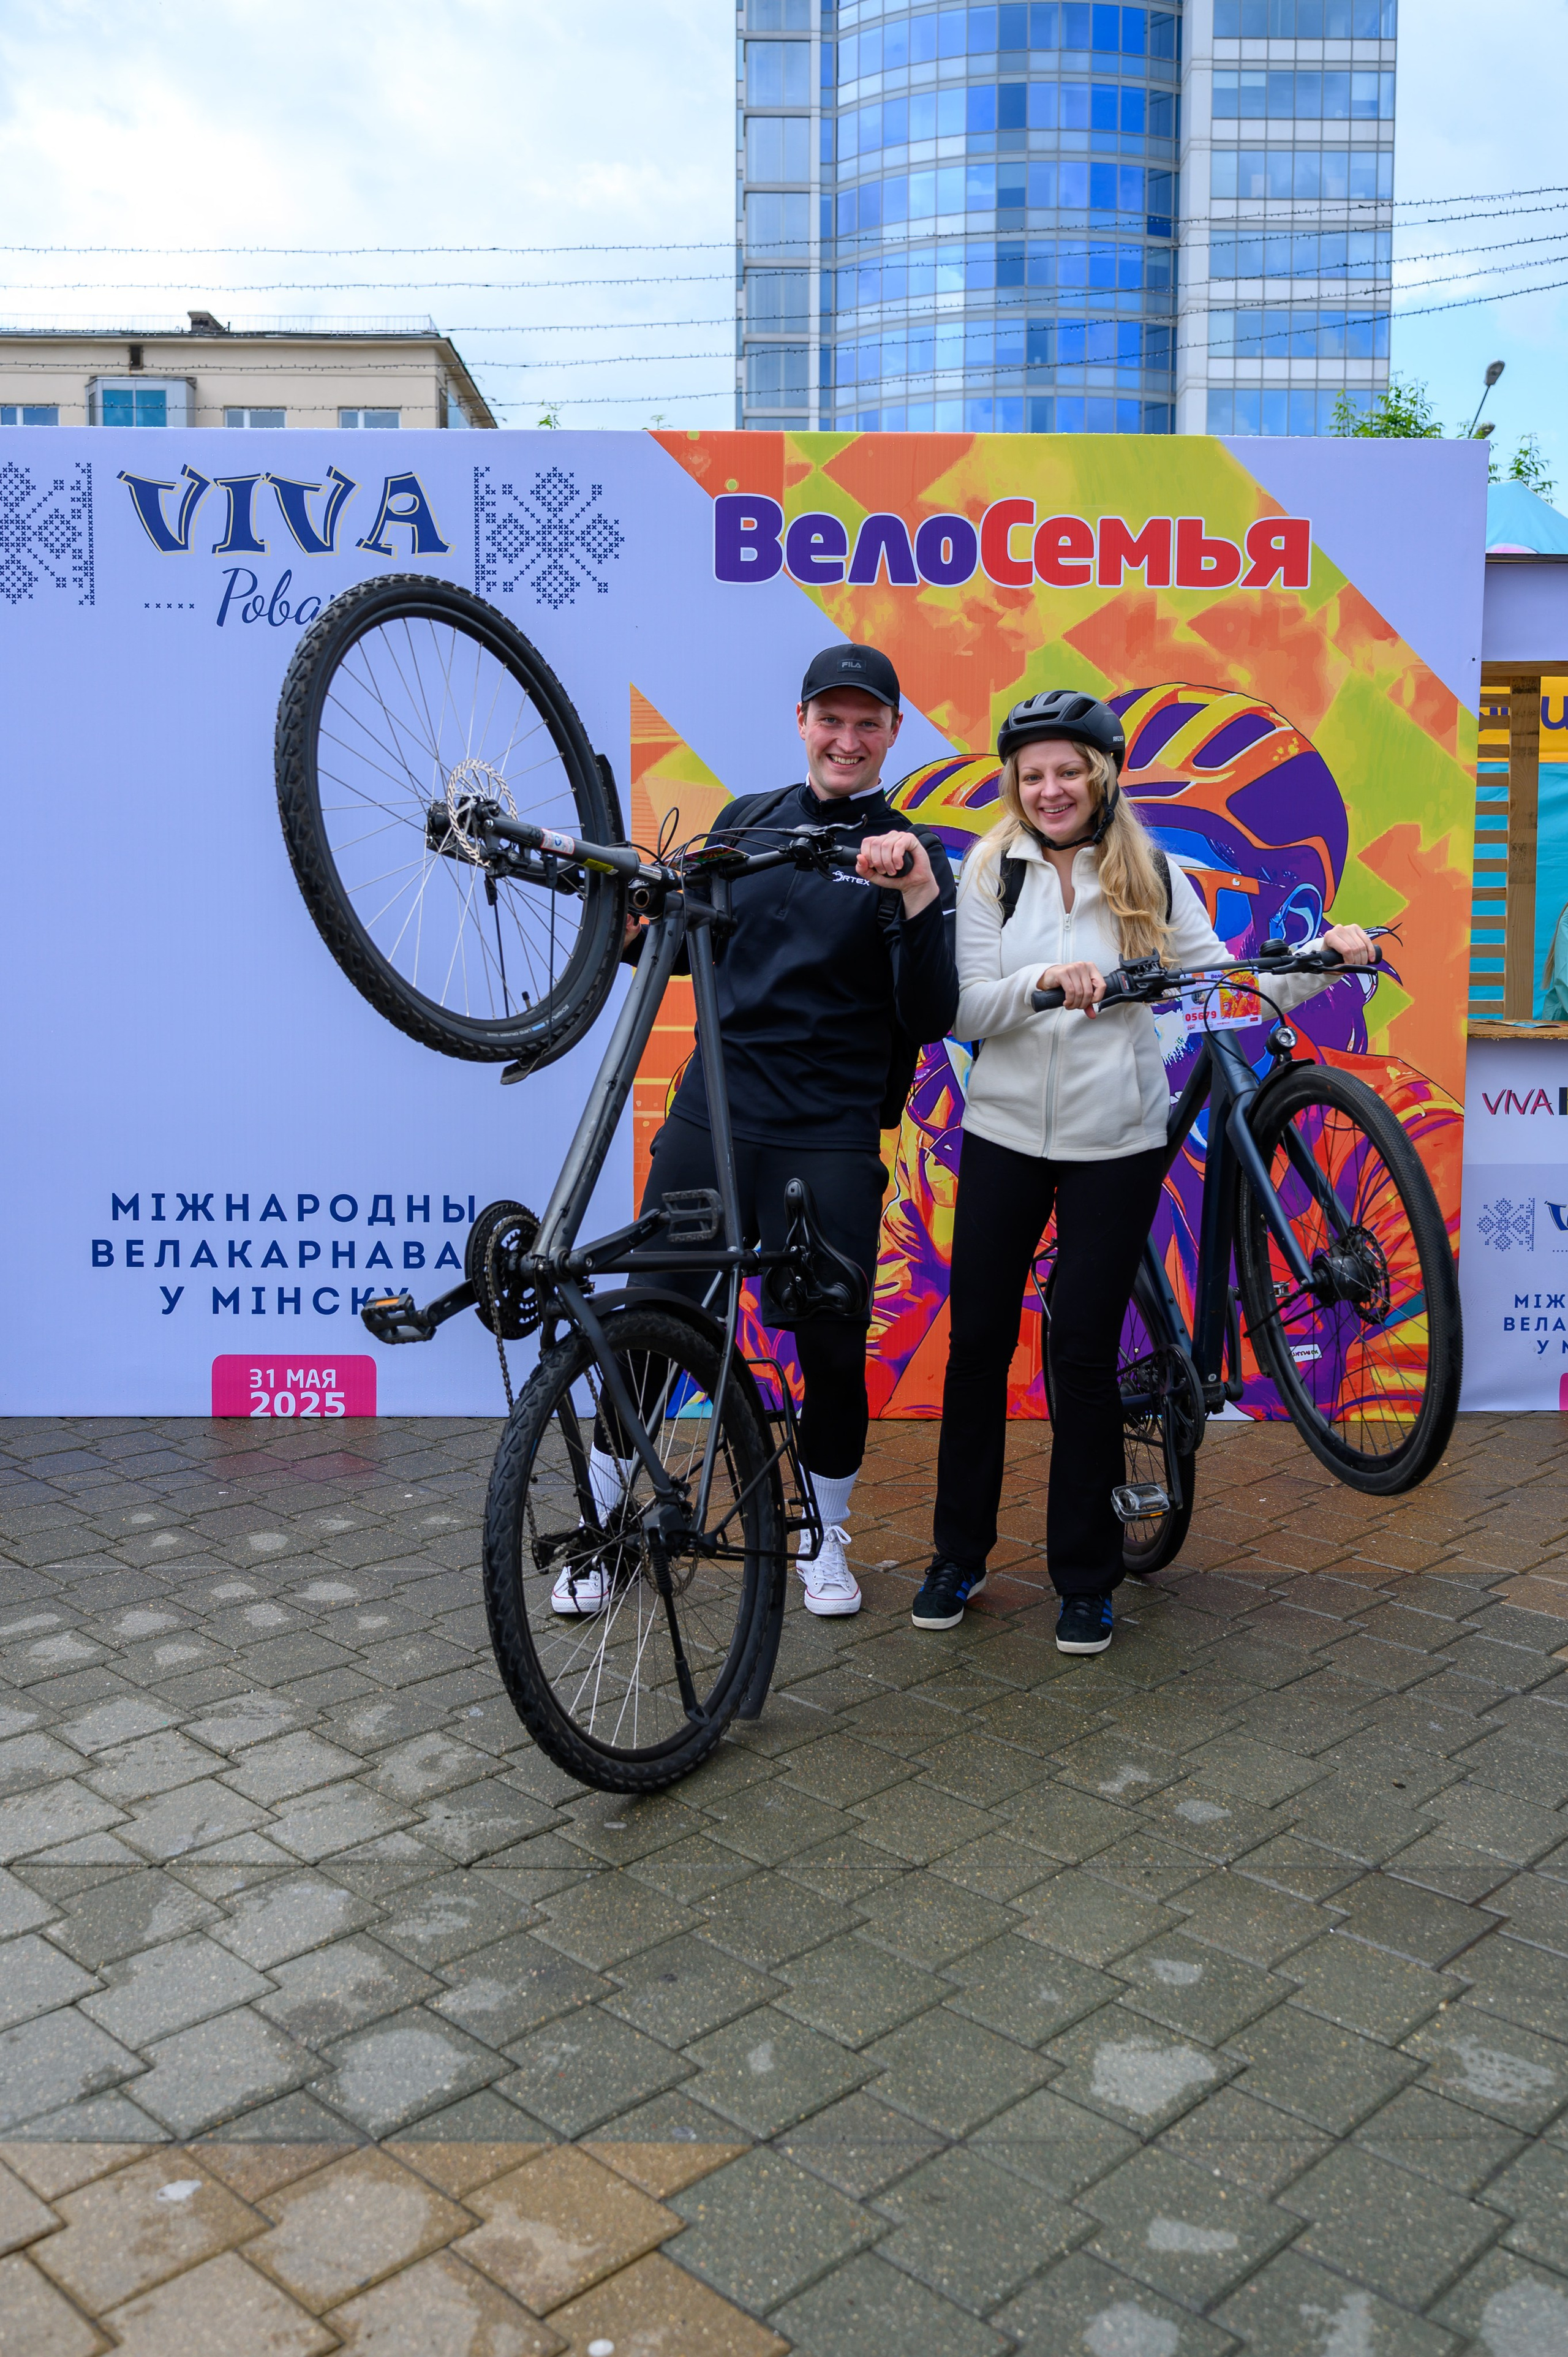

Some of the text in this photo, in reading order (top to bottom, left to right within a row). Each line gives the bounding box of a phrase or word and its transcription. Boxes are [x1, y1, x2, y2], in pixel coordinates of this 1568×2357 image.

[116, 464, 455, 558] VIVA
[714, 495, 1311, 588] ВелоСемья
[216, 568, 336, 627] Рова
[1481, 1088, 1555, 1115] VIVA
[111, 1192, 476, 1227] МІЖНАРОДНЫ
[92, 1239, 462, 1270] ВЕЛАКАРНАВА
[159, 1286, 185, 1315] У
[1515, 1294, 1566, 1308] МІЖ
[1504, 1317, 1566, 1332] ВЕЛА
[249, 1368, 336, 1389] 31 МАЯ
[250, 1391, 345, 1417] 2025
